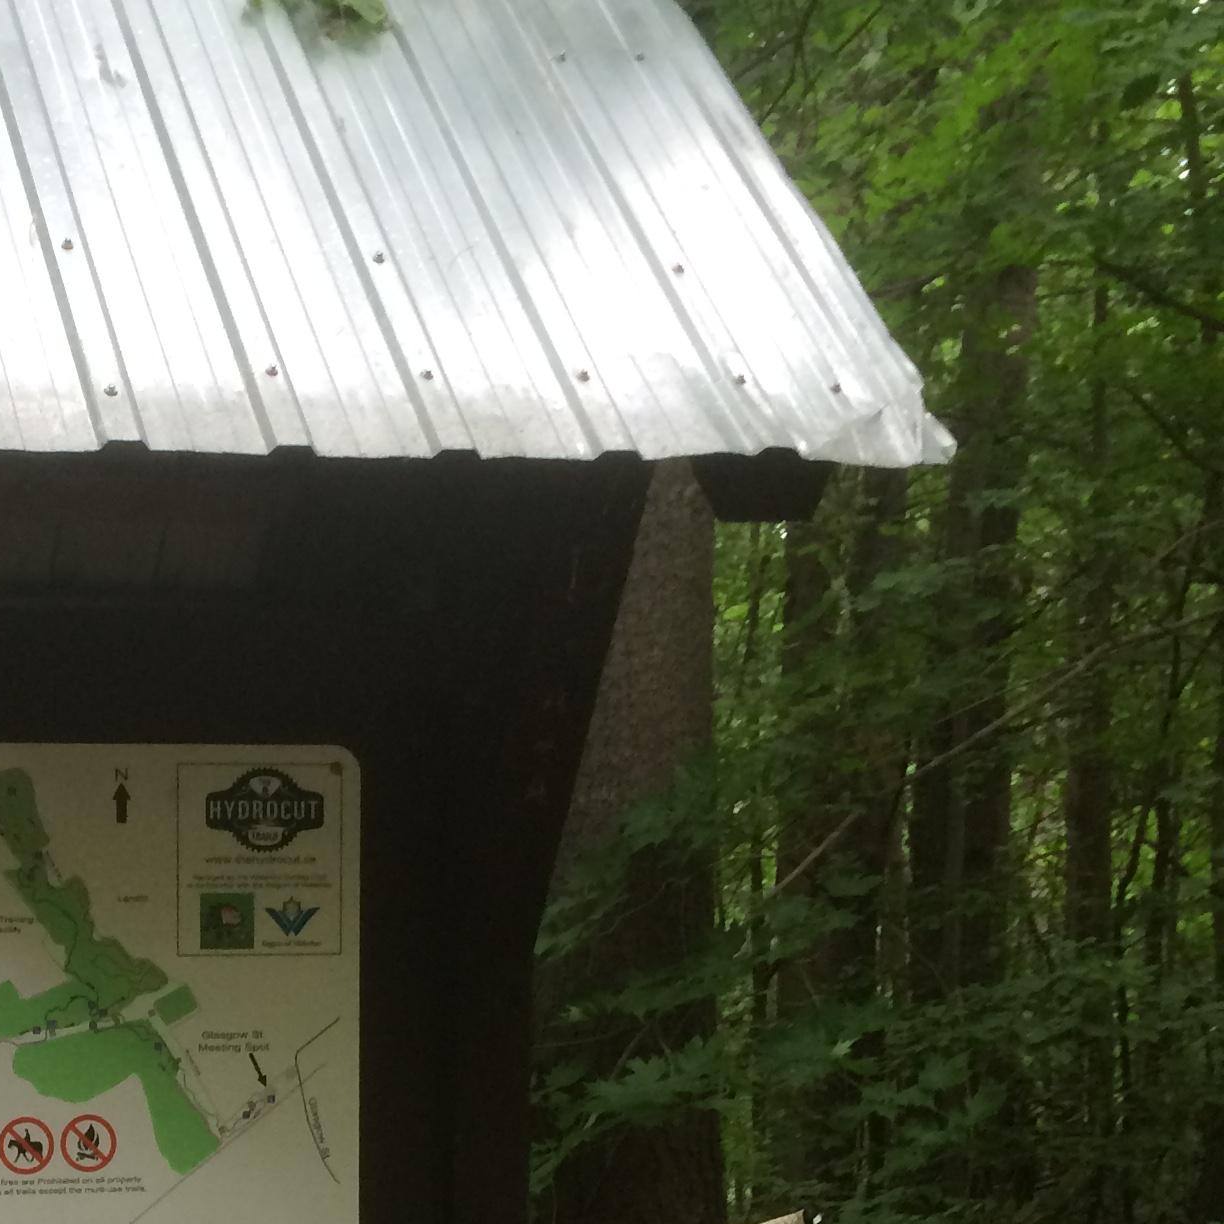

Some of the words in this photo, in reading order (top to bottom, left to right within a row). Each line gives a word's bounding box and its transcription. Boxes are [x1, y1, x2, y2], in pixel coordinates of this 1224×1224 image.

[115, 767, 128, 782] N
[209, 799, 319, 822] HYDROCUT
[201, 1031, 248, 1041] Glasgow
[198, 1043, 241, 1053] Meeting
[245, 1042, 270, 1052] Spot
[37, 1177, 80, 1185] Prohibited
[38, 1187, 66, 1195] except
